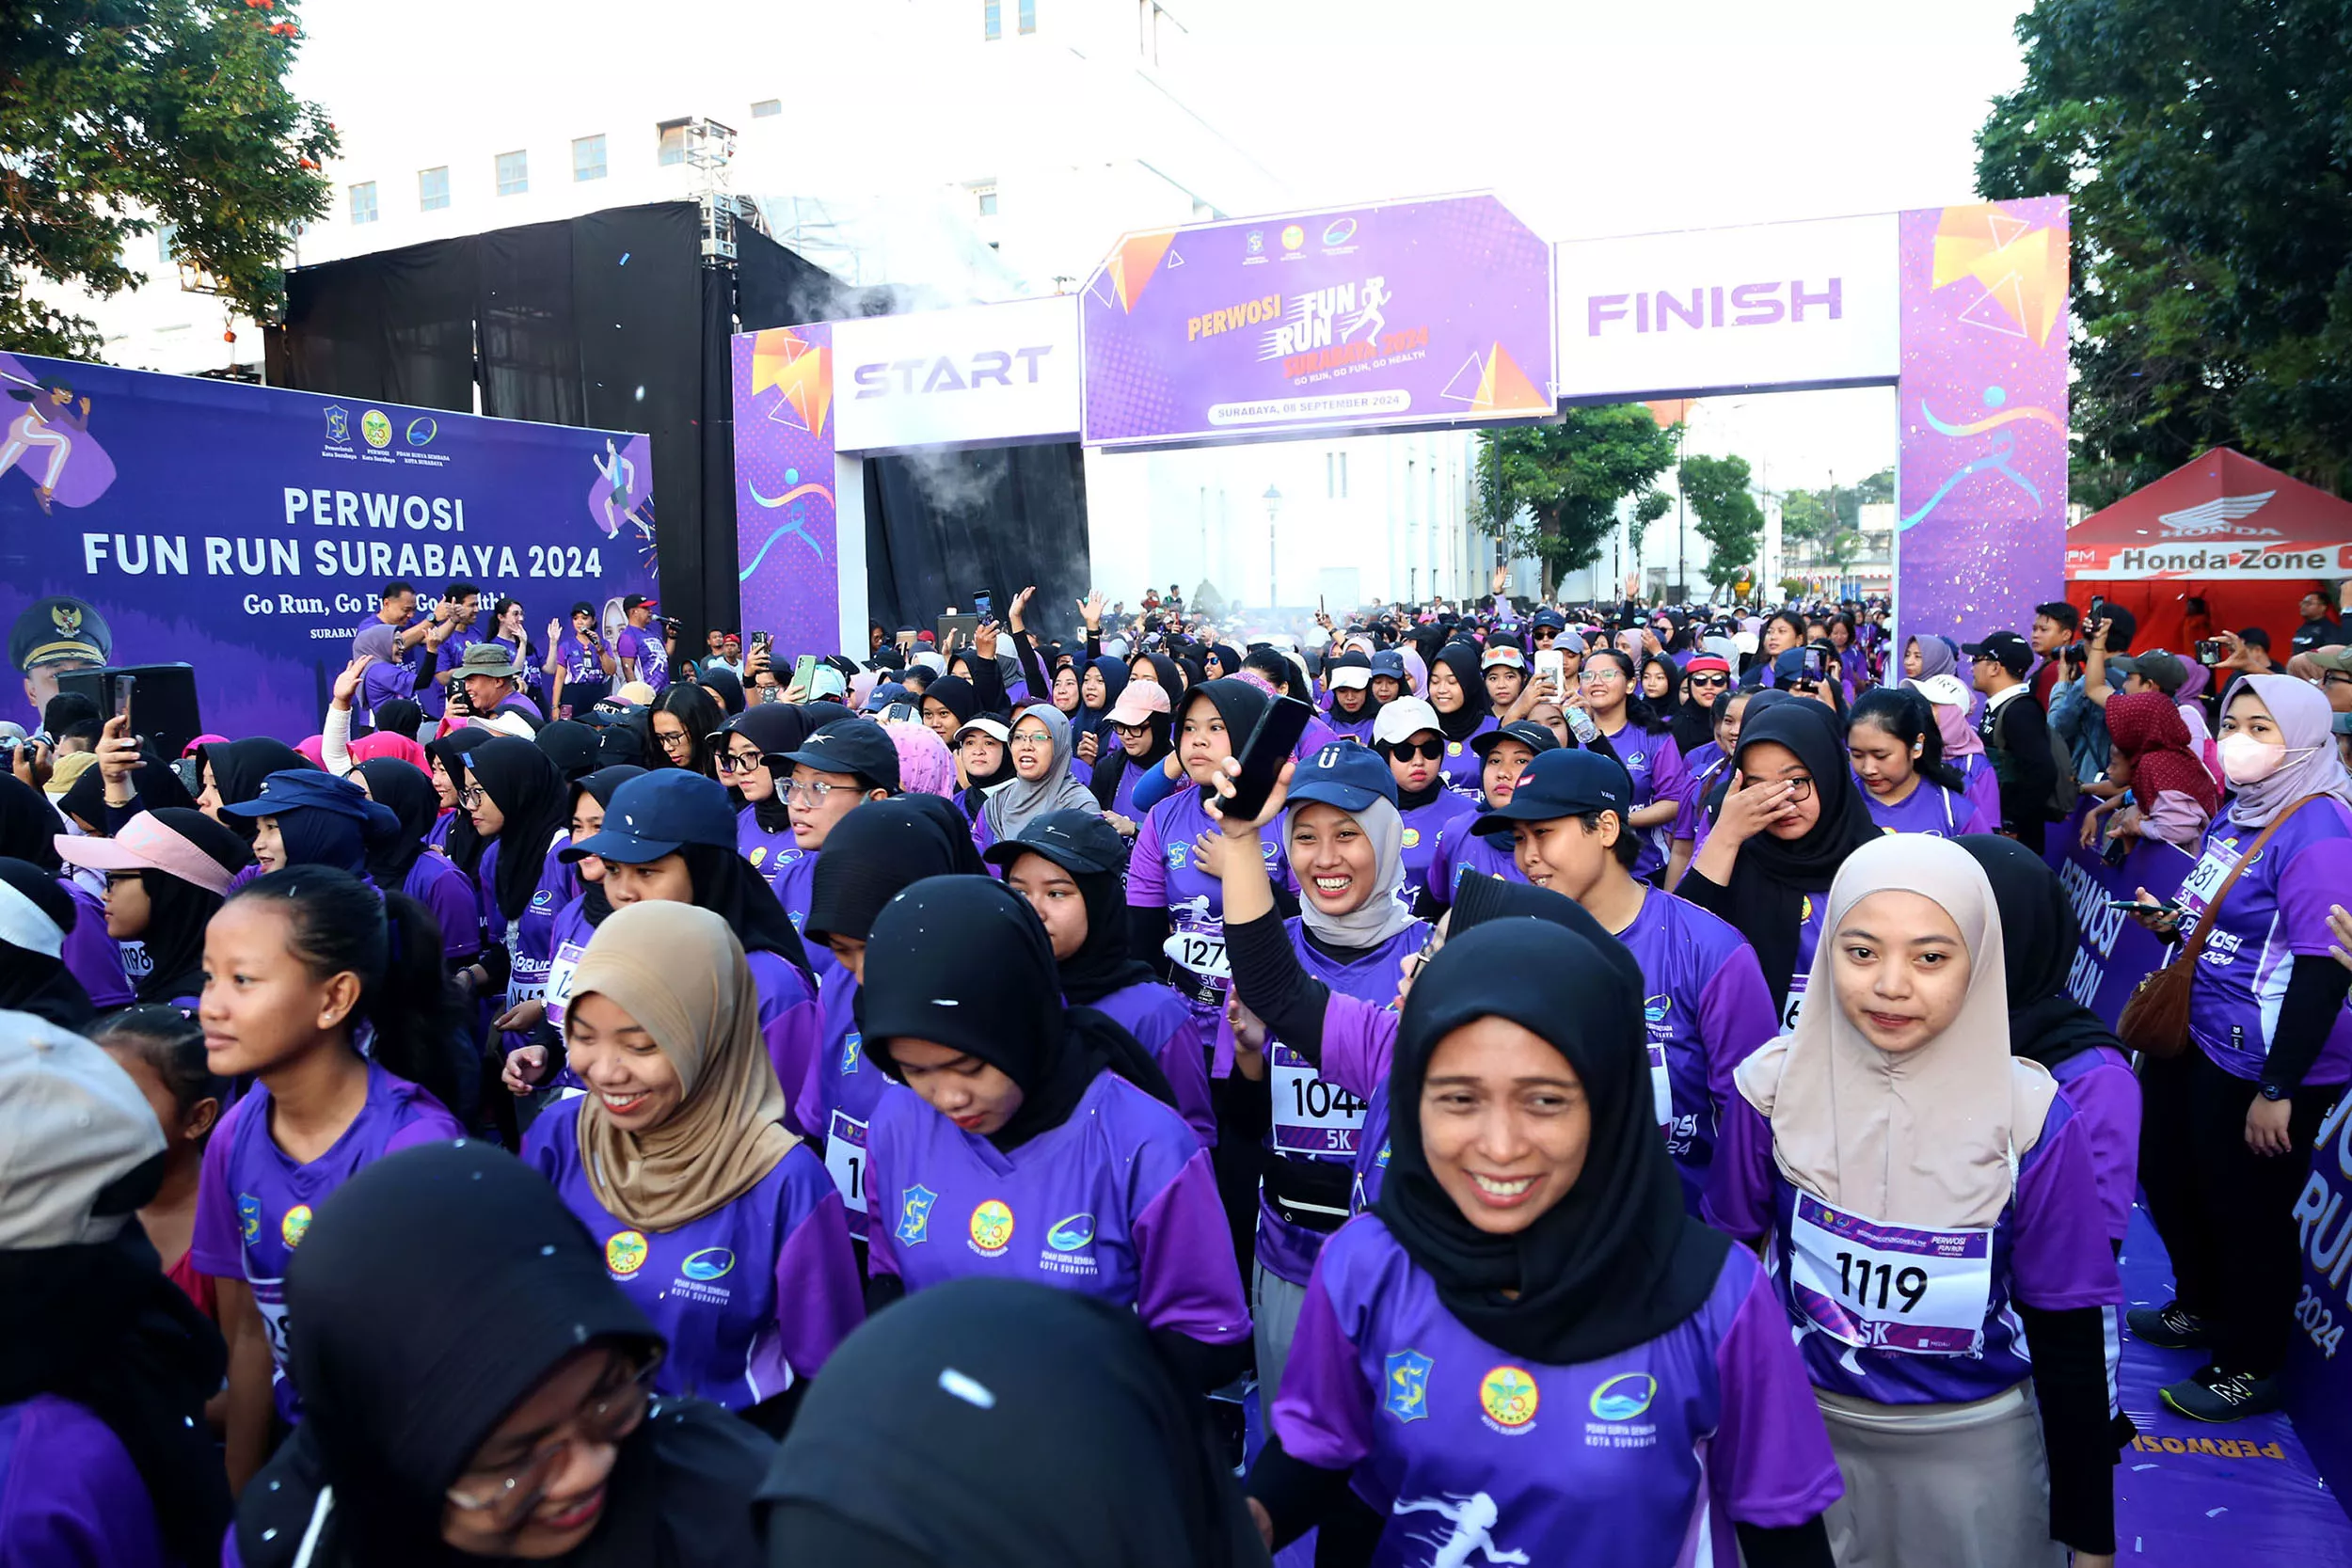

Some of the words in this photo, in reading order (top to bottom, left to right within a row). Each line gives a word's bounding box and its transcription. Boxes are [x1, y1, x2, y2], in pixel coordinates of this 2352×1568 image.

[1298, 281, 1356, 318] FUN
[1588, 277, 1842, 337] FINISH
[1187, 293, 1282, 342] PERWOSI
[1274, 316, 1332, 357] RUN
[1282, 340, 1378, 378] SURABAYA
[1381, 325, 1430, 356] 2024
[854, 344, 1054, 400] START
[1294, 377, 1308, 386] GO
[1309, 372, 1332, 383] RUN,
[1333, 368, 1347, 377] GO
[1349, 363, 1372, 374] FUN,
[1373, 359, 1387, 369] GO
[1388, 349, 1426, 365] HEALTH
[1217, 404, 1280, 419] SURABAYA,
[1282, 403, 1297, 413] 08
[1299, 397, 1369, 412] SEPTEMBER
[1372, 395, 1400, 406] 2024
[284, 486, 464, 531] PERWOSI
[2159, 523, 2283, 538] HONDA
[83, 532, 189, 575] FUN
[204, 536, 301, 576] RUN
[314, 539, 519, 578] SURABAYA
[528, 545, 602, 578] 2024
[2122, 548, 2227, 571] Honda
[2238, 548, 2327, 570] Zone
[243, 594, 274, 614] Go
[278, 594, 330, 616] Run,
[335, 593, 362, 613] Go
[416, 593, 439, 612] Go
[310, 627, 358, 640] SURABAY
[2178, 889, 2194, 906] 5K
[1184, 938, 1231, 972] 127
[1200, 974, 1218, 988] 5K
[2064, 944, 2104, 1009] RUN
[1327, 1130, 1352, 1149] 5K
[1931, 1236, 1966, 1245] PERWOSI
[1040, 1260, 1058, 1272] KOTA
[672, 1287, 690, 1298] KOTA
[1836, 1252, 1928, 1313] 1119
[1859, 1319, 1891, 1345] 5K
[2294, 1284, 2345, 1360] 2024
[1585, 1435, 1611, 1447] KOTA
[2130, 1434, 2286, 1460] PERWOSI
